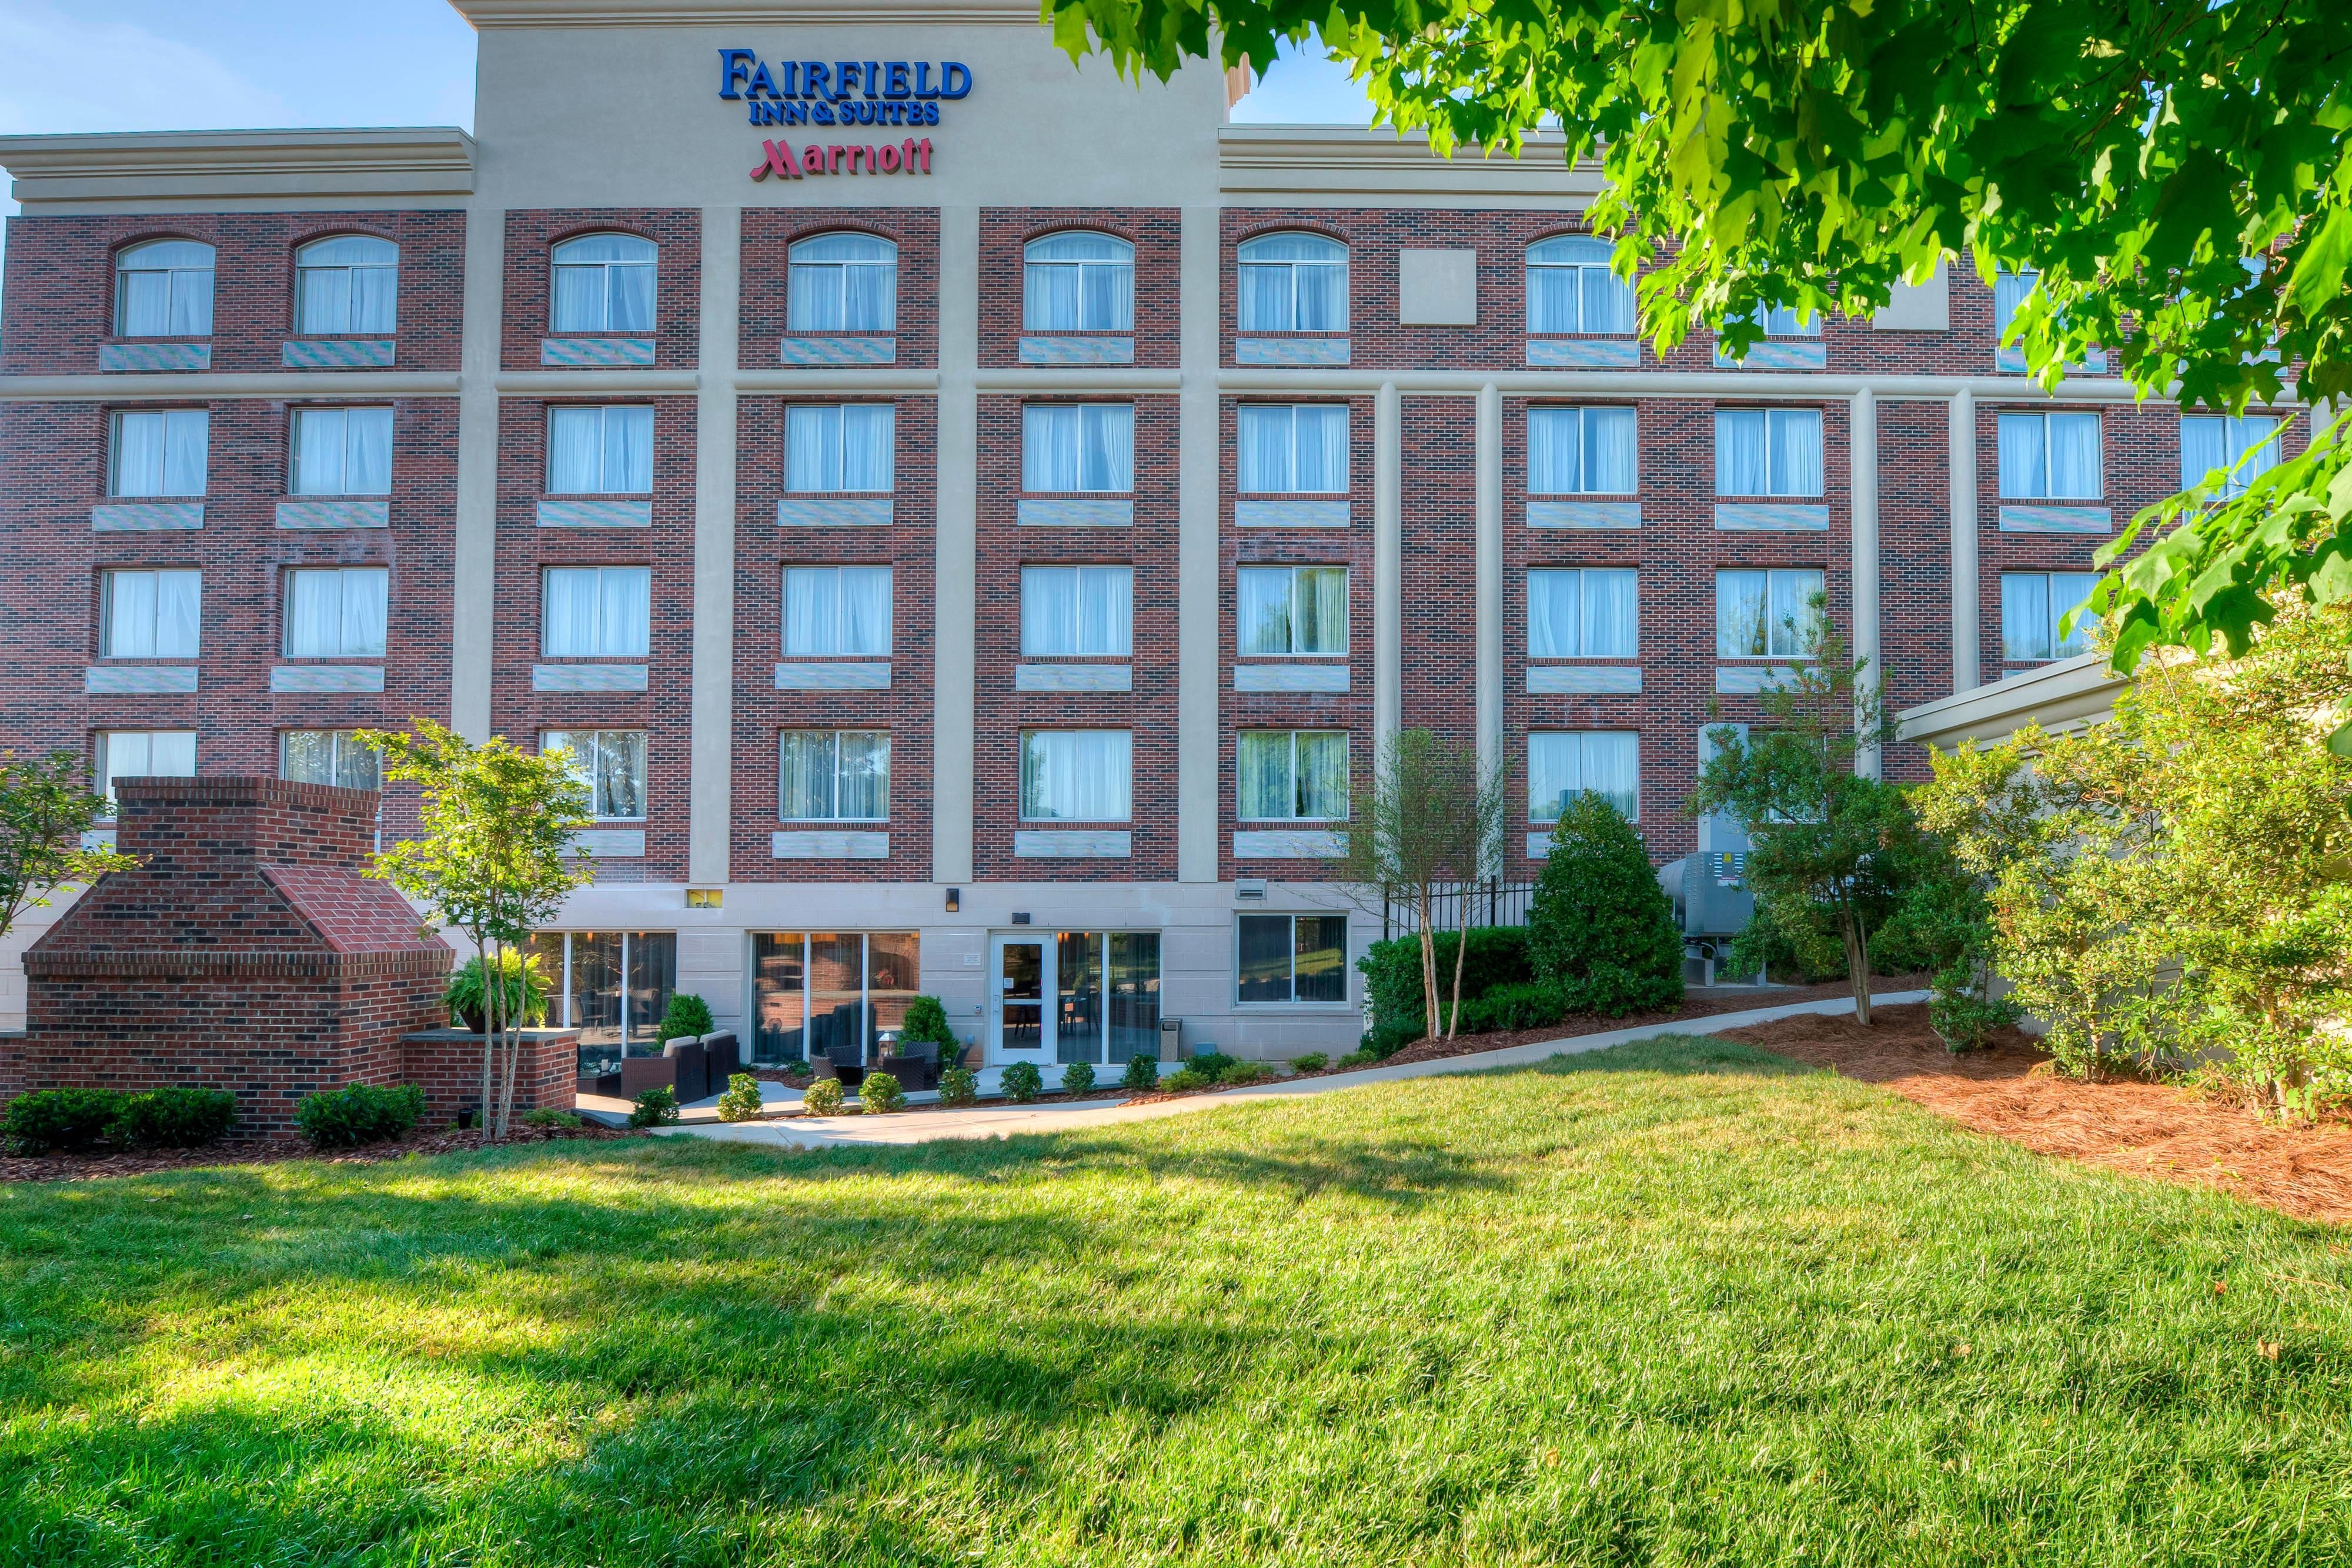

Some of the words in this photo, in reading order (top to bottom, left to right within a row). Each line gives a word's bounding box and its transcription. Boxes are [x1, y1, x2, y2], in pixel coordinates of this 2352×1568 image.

[717, 48, 973, 103] FAIRFIELD
[748, 101, 809, 126] INN
[811, 101, 836, 126] &
[838, 101, 940, 126] SUITES
[749, 137, 934, 182] Marriott
